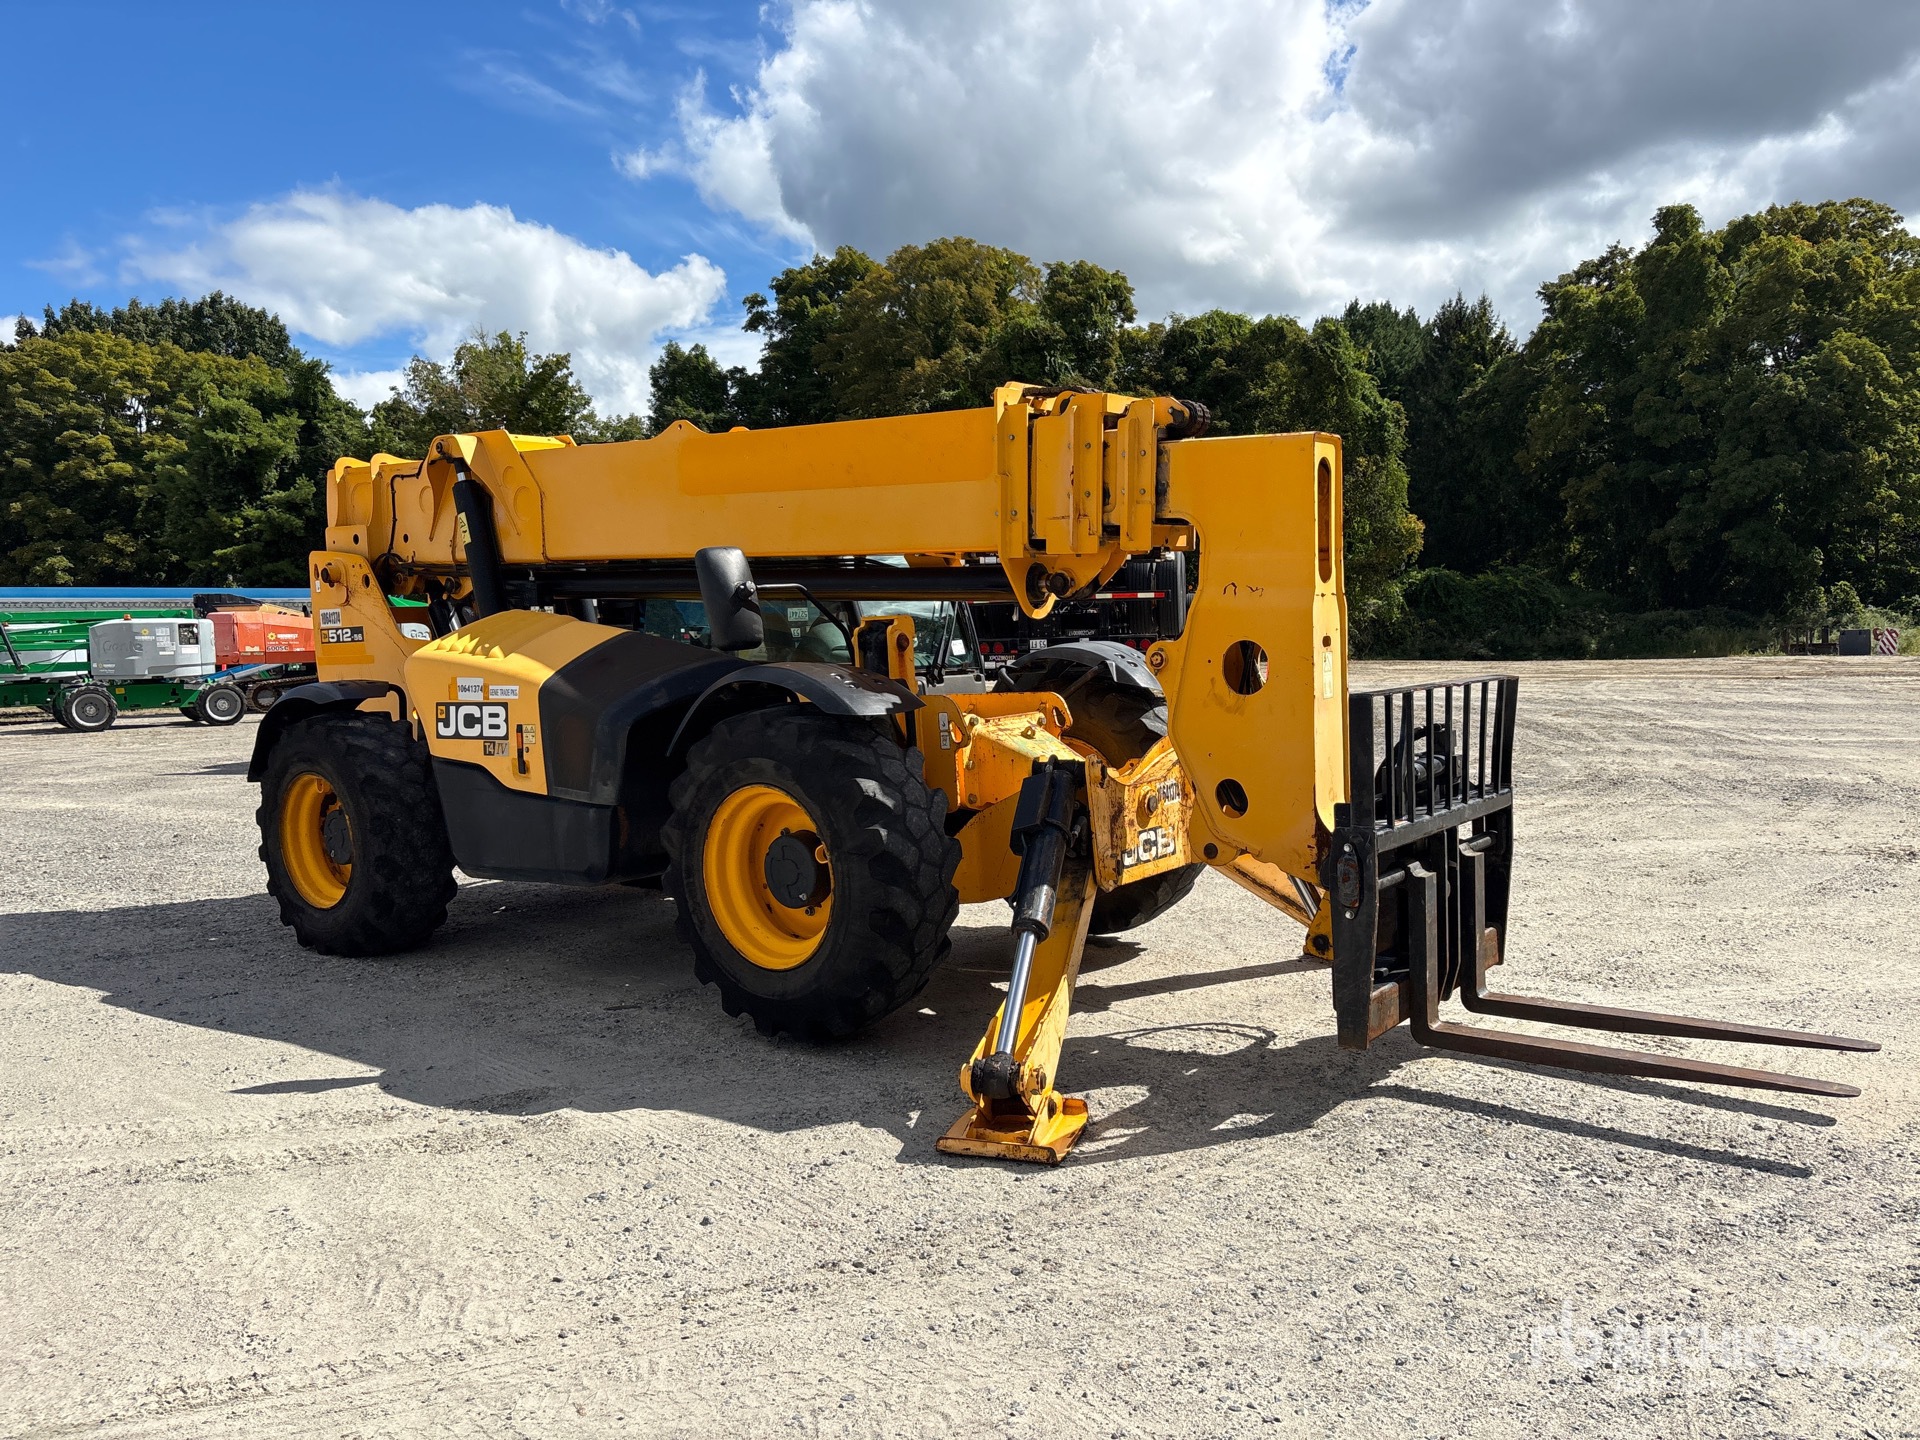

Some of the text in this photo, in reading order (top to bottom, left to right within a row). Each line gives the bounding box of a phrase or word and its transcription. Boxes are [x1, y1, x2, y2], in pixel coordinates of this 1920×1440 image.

[1031, 640, 1038, 649] FT
[458, 684, 483, 693] 10641374
[437, 705, 507, 737] JCB
[484, 742, 508, 755] T4 IV
